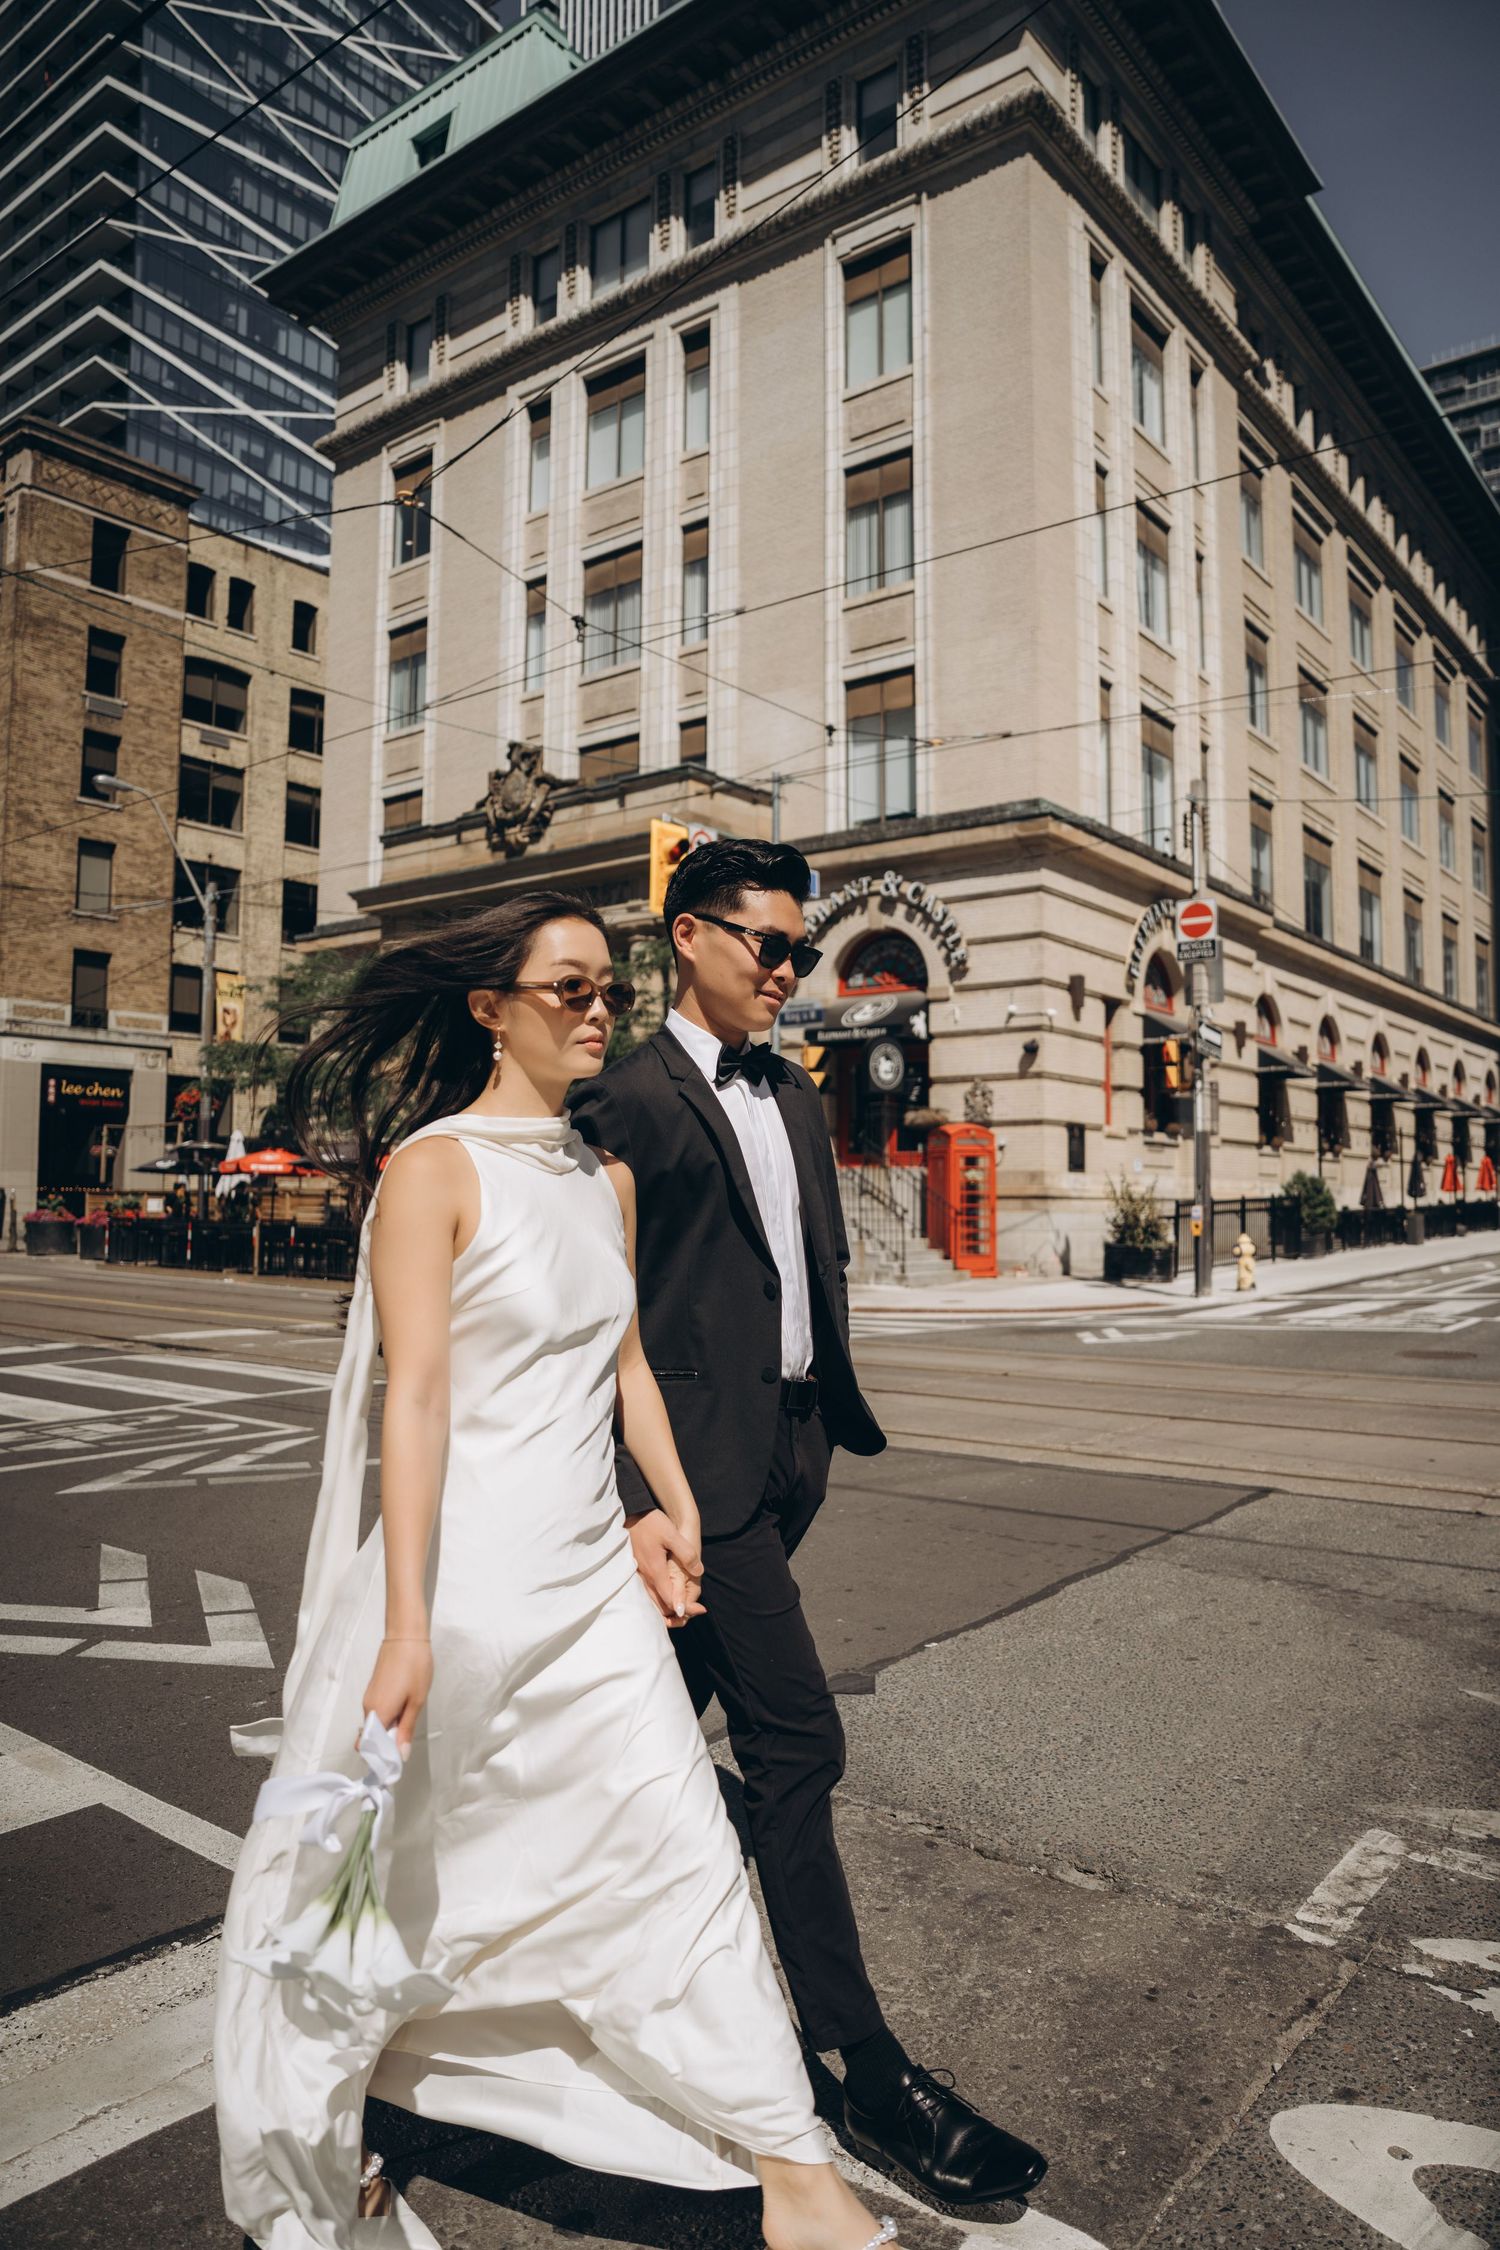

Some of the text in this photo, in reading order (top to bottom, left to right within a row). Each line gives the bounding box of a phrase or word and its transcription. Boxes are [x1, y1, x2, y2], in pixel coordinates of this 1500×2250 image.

[804, 870, 968, 966] PHANT & CASTLE
[1180, 941, 1212, 951] BICYCLES
[1178, 949, 1214, 959] EXCEPTED
[61, 1080, 84, 1097] lee
[85, 1081, 124, 1098] chen
